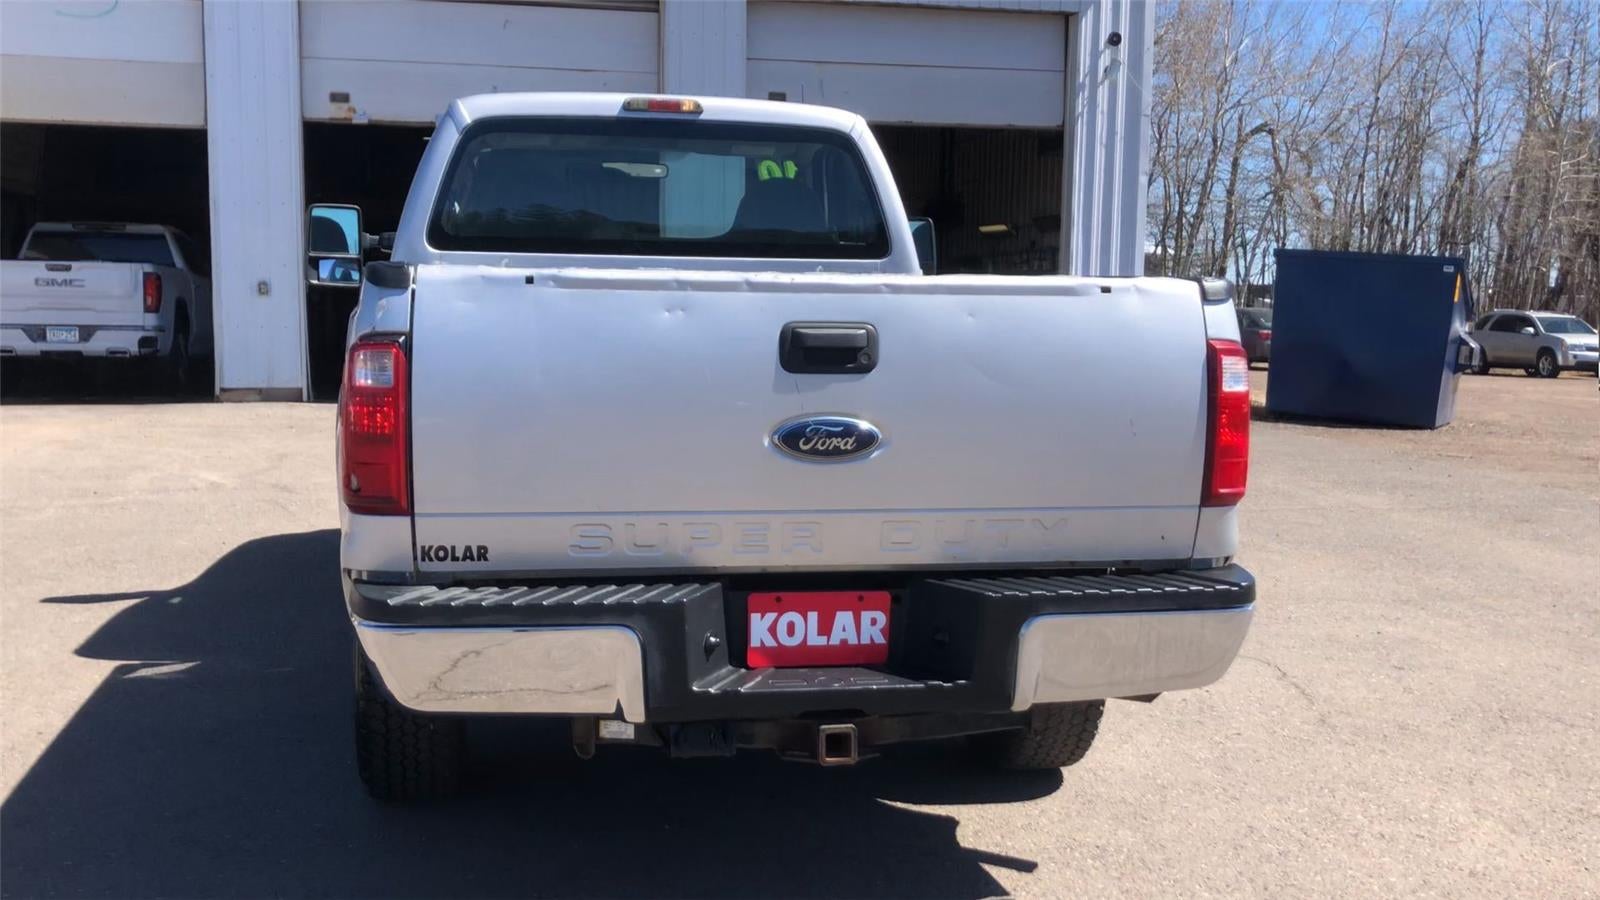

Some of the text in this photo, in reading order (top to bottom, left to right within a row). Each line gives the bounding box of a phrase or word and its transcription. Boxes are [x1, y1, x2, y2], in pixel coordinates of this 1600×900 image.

[35, 277, 86, 288] GMC
[799, 422, 857, 450] Ford
[567, 517, 1069, 557] SUPER DUTY
[420, 544, 489, 562] KOLAR
[750, 611, 887, 647] KOLAR
